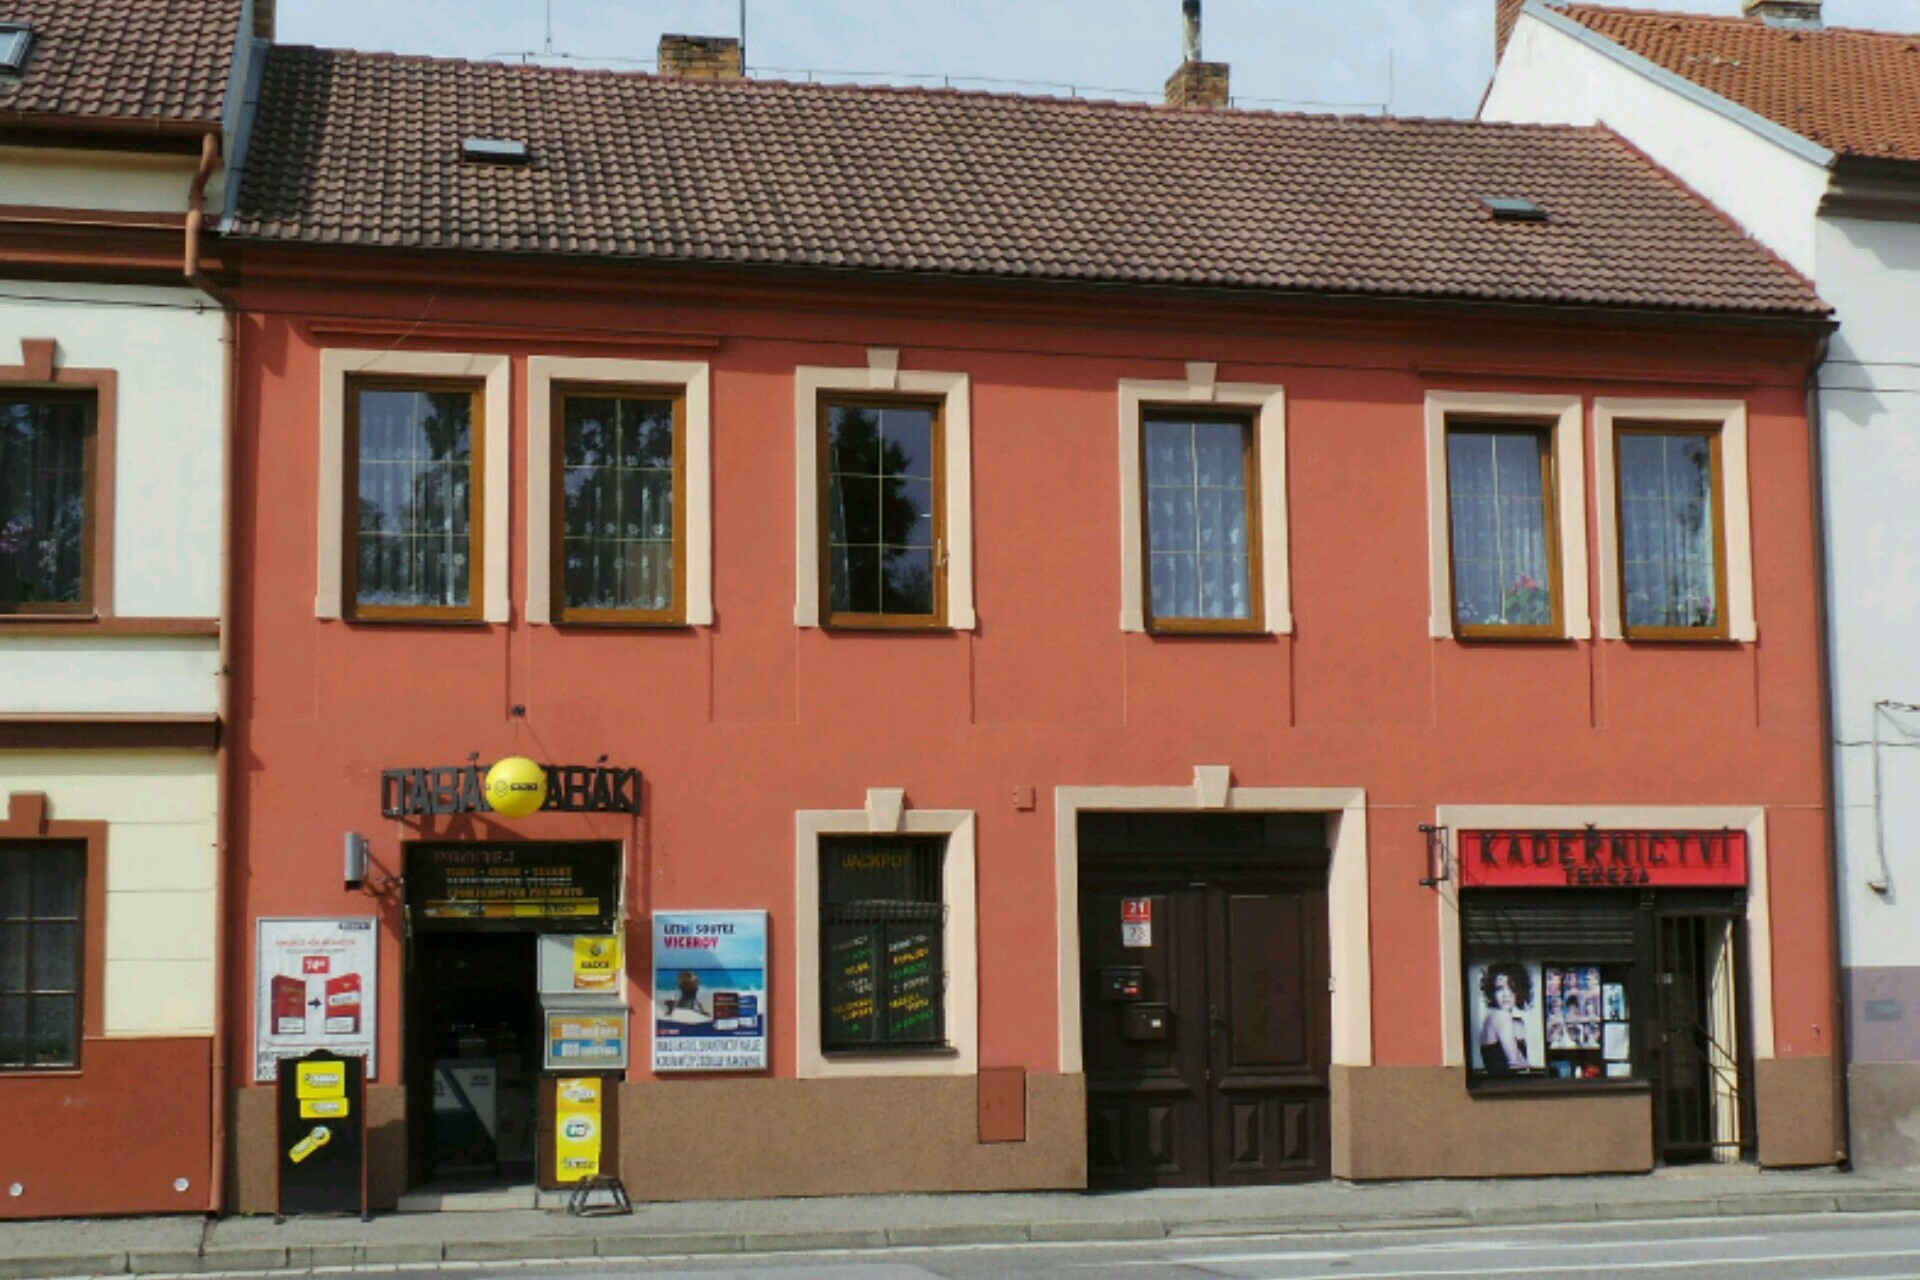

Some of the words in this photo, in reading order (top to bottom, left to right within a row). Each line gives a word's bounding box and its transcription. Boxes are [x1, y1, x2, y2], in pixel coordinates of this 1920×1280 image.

[386, 752, 492, 815] TABÁ
[542, 755, 637, 813] ABÁK
[1479, 823, 1730, 865] KADEŘNICTVÍ
[842, 854, 911, 868] JACKPOT
[1564, 866, 1650, 884] TEREZA
[1129, 901, 1145, 914] 21
[664, 936, 719, 948] VICEROY
